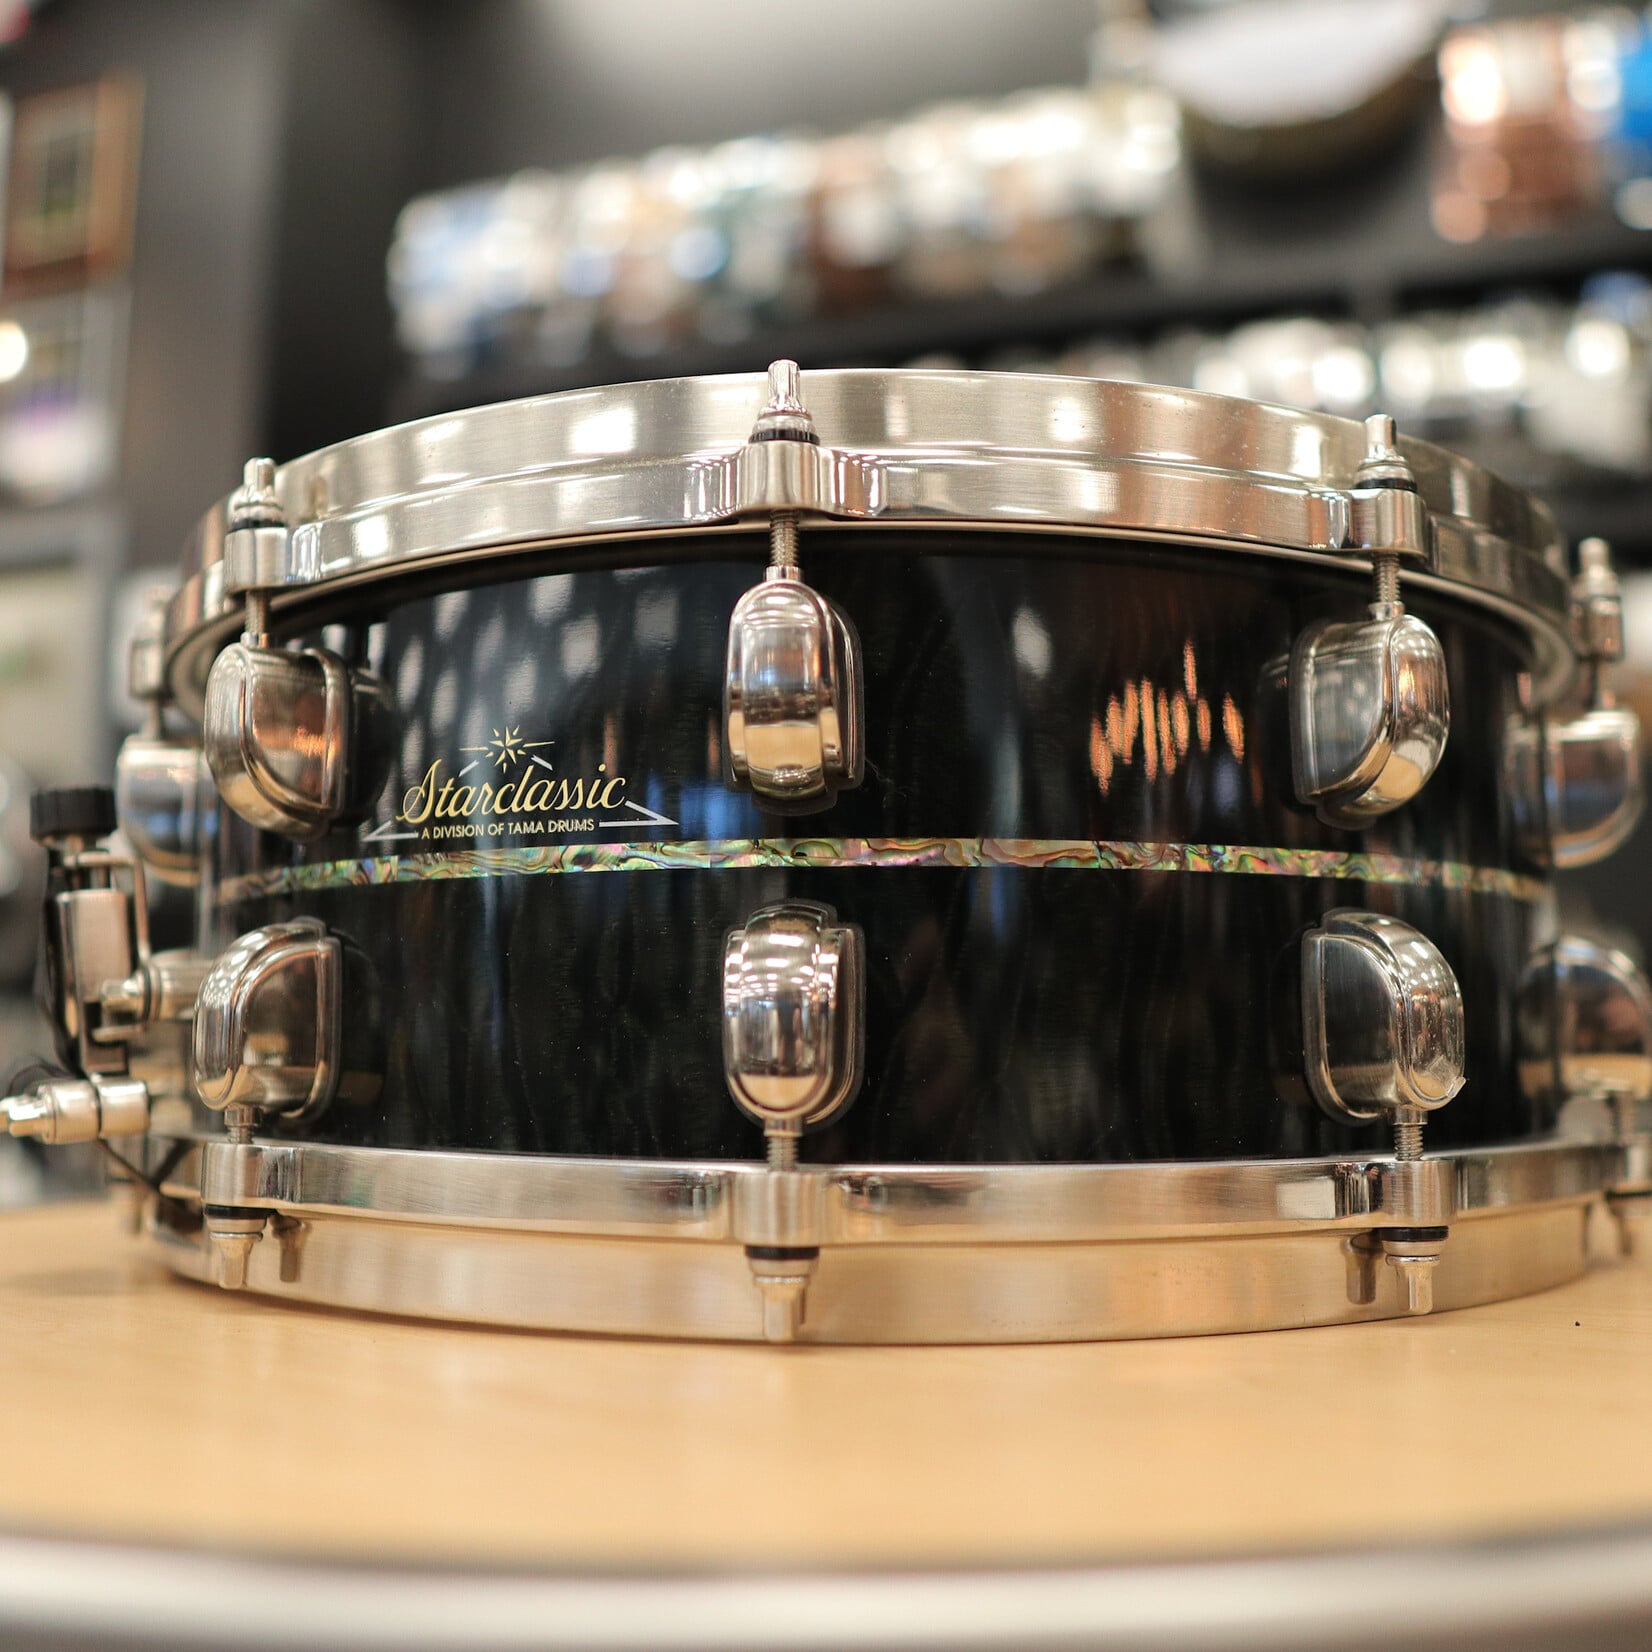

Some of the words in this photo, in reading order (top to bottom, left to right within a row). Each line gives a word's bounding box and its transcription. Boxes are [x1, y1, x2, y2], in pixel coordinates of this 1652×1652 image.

[395, 758, 626, 824] Starclassic
[421, 828, 430, 840] A
[433, 824, 482, 839] DIVISION
[487, 823, 504, 836] OF
[508, 820, 544, 835] TAMA
[548, 818, 595, 833] DRUMS
